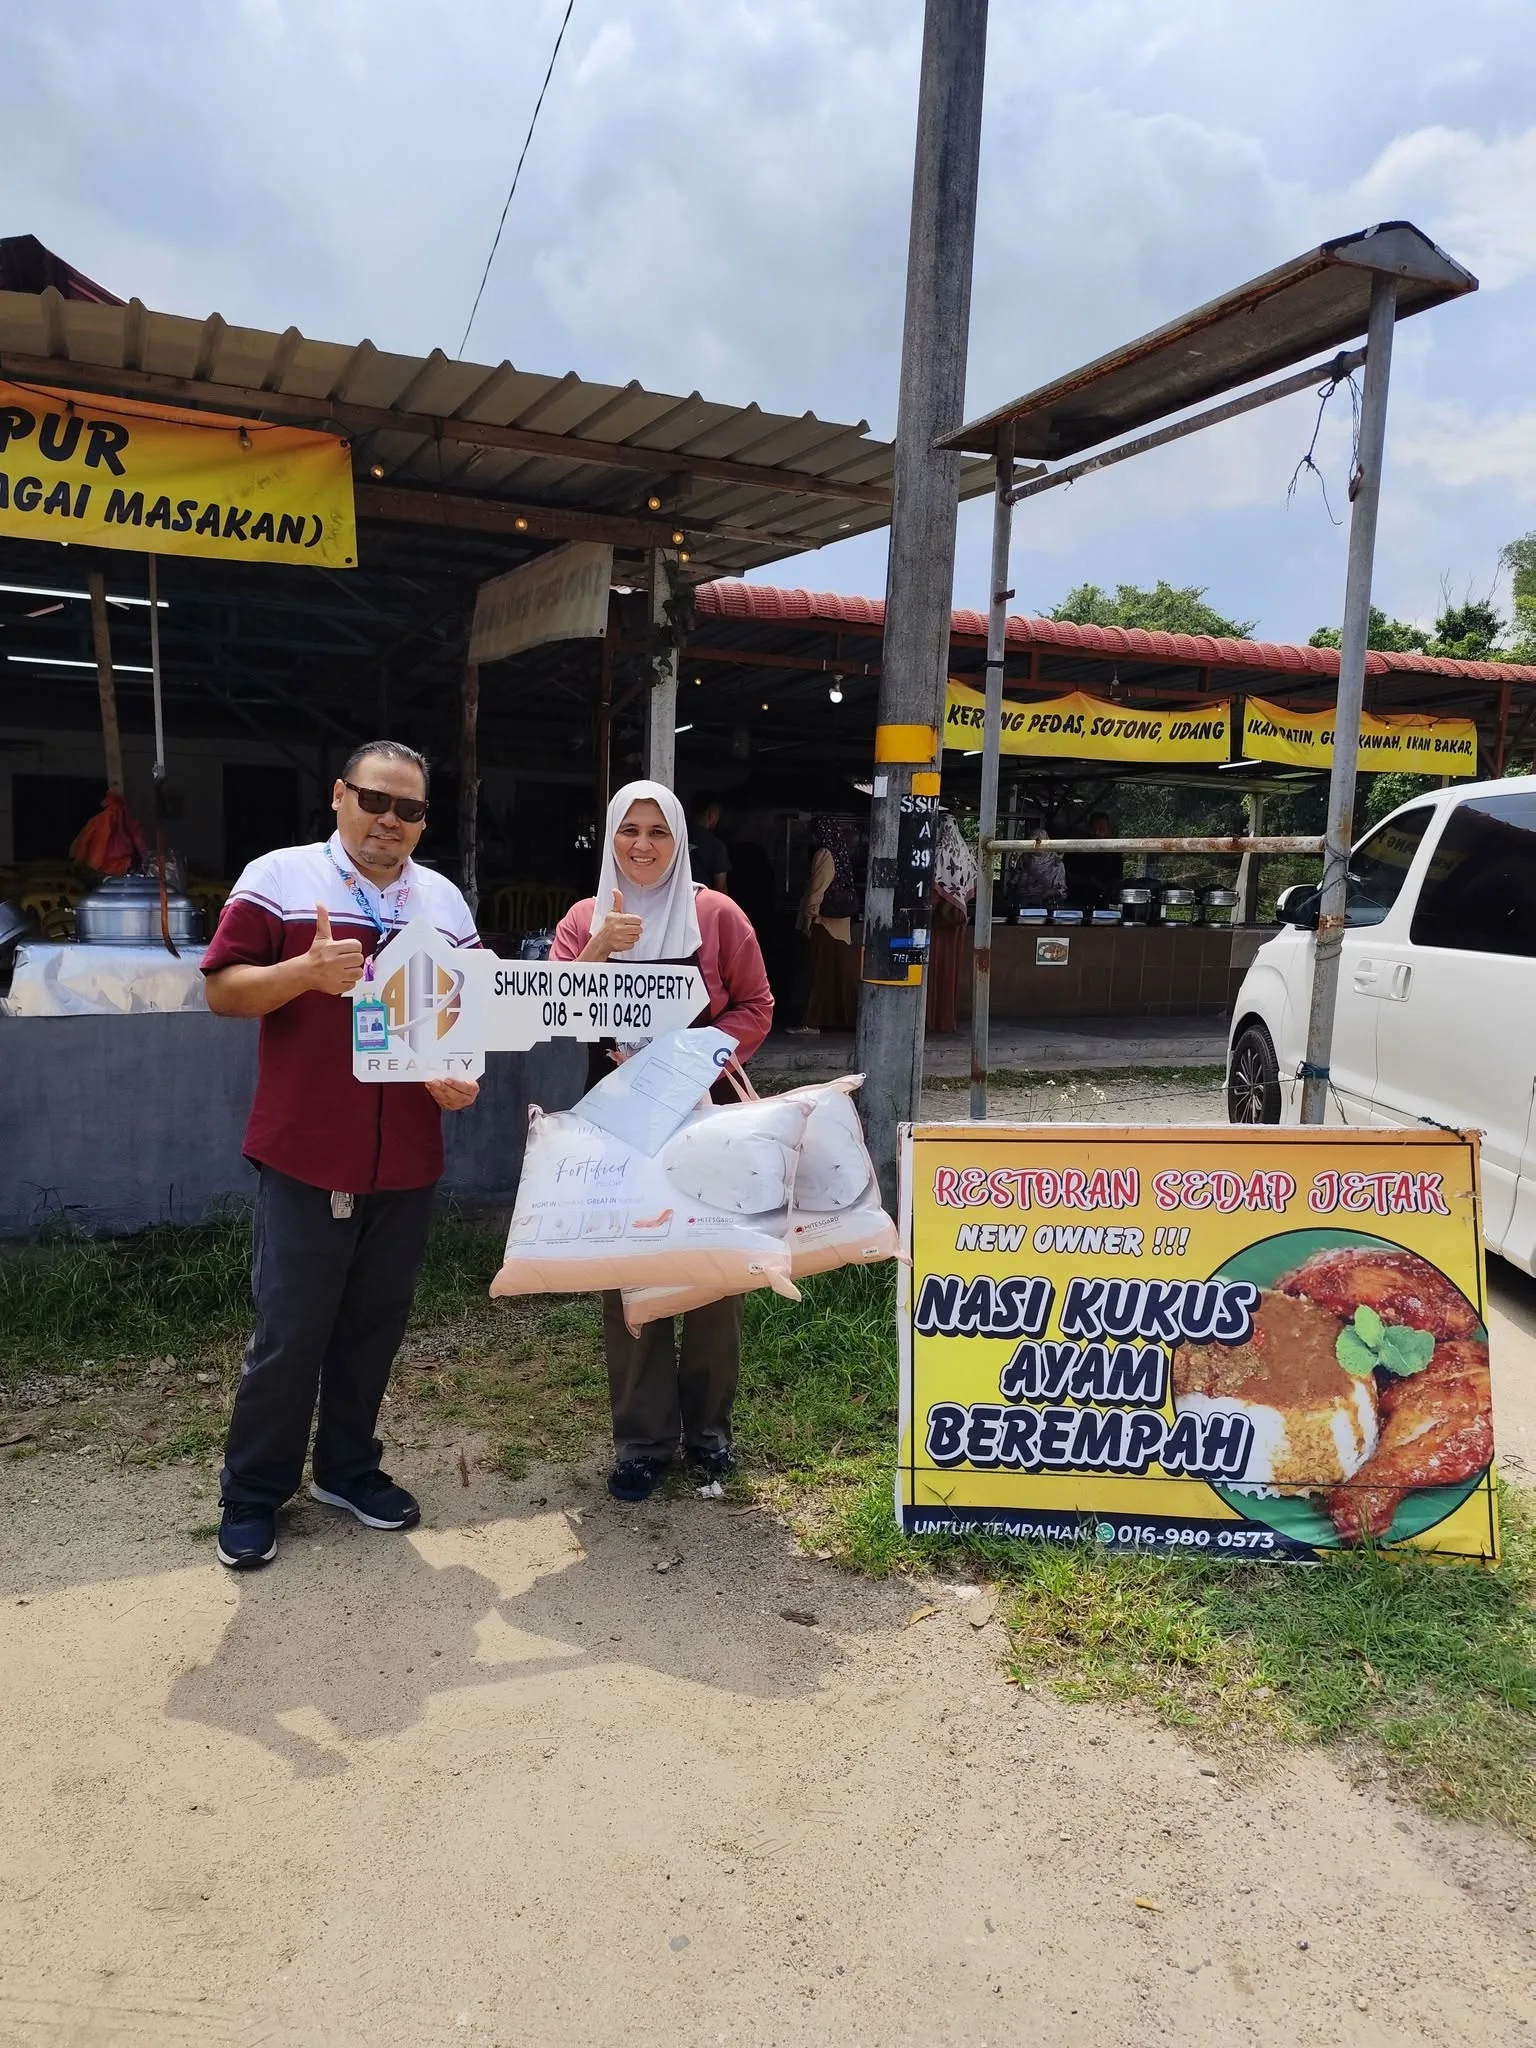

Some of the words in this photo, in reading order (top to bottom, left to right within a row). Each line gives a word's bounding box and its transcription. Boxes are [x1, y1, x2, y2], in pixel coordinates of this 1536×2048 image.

[104, 489, 323, 547] MASAKAN)
[947, 704, 1025, 732] KERNG
[1027, 714, 1085, 738] PEDAS,
[1090, 717, 1162, 743] SOTONG,
[1169, 721, 1224, 740] UDANG
[1406, 736, 1431, 751] IKAN
[1434, 738, 1473, 756] BAKAR,
[919, 821, 931, 838] A
[911, 850, 930, 867] 39
[916, 881, 924, 897] 1
[494, 971, 552, 996] SHUKRI
[558, 972, 608, 998] OMAR
[614, 974, 694, 1000] PROPERTY
[542, 1001, 567, 1026] 018
[589, 1002, 608, 1027] 911
[613, 1003, 651, 1028] 0420
[556, 1156, 630, 1184] Fortified
[933, 1166, 1140, 1211] RESTORAN
[1152, 1168, 1296, 1213] SEDAP
[1308, 1170, 1451, 1215] JETAK
[955, 1224, 1027, 1252] NEW
[1033, 1225, 1144, 1257] OWNER
[1152, 1227, 1191, 1256] !!!
[914, 1274, 1055, 1337] NASI
[1059, 1277, 1262, 1346] KUKUS
[1001, 1340, 1170, 1407] AYAM
[927, 1403, 1254, 1479] BEREMPAH
[914, 1520, 977, 1536] UNTUK
[1118, 1525, 1210, 1546] 016-980
[1217, 1530, 1274, 1549] 0573
